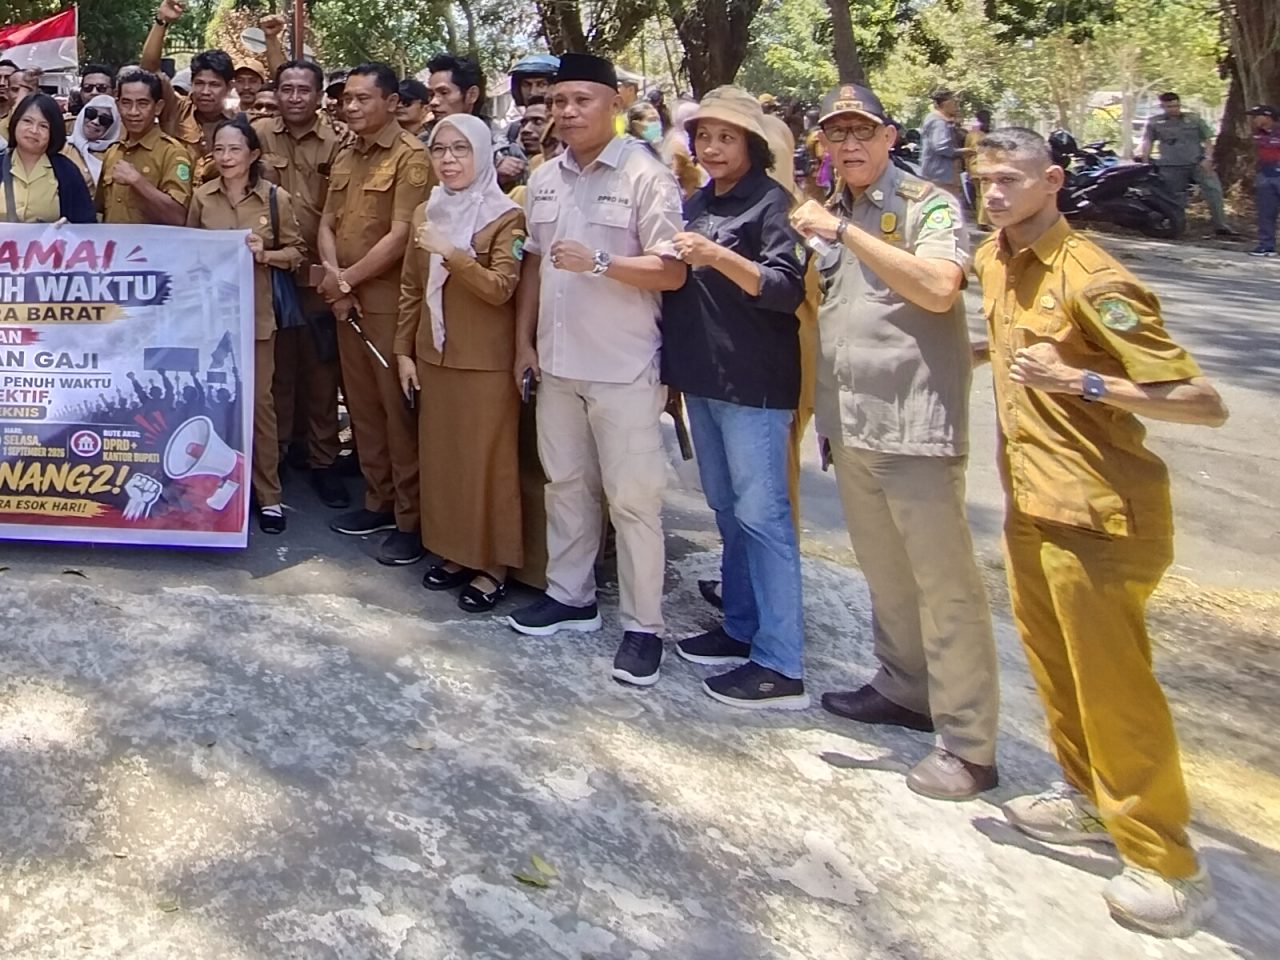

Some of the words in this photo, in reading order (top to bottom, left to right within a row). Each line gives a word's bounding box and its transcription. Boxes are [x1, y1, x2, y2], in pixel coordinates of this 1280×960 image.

[35, 275, 157, 302] WAKTU
[27, 306, 106, 321] BARAT
[34, 351, 99, 369] GAJI
[3, 377, 55, 388] PENUH
[58, 378, 112, 389] WAKTU
[3, 434, 41, 447] SELASA,
[103, 438, 130, 451] DPRD
[8, 446, 46, 456] SEPTEMBER
[103, 451, 132, 462] KANTOR
[134, 452, 160, 463] BUPATI
[16, 500, 48, 511] ESOK
[53, 501, 88, 513] HARI!
